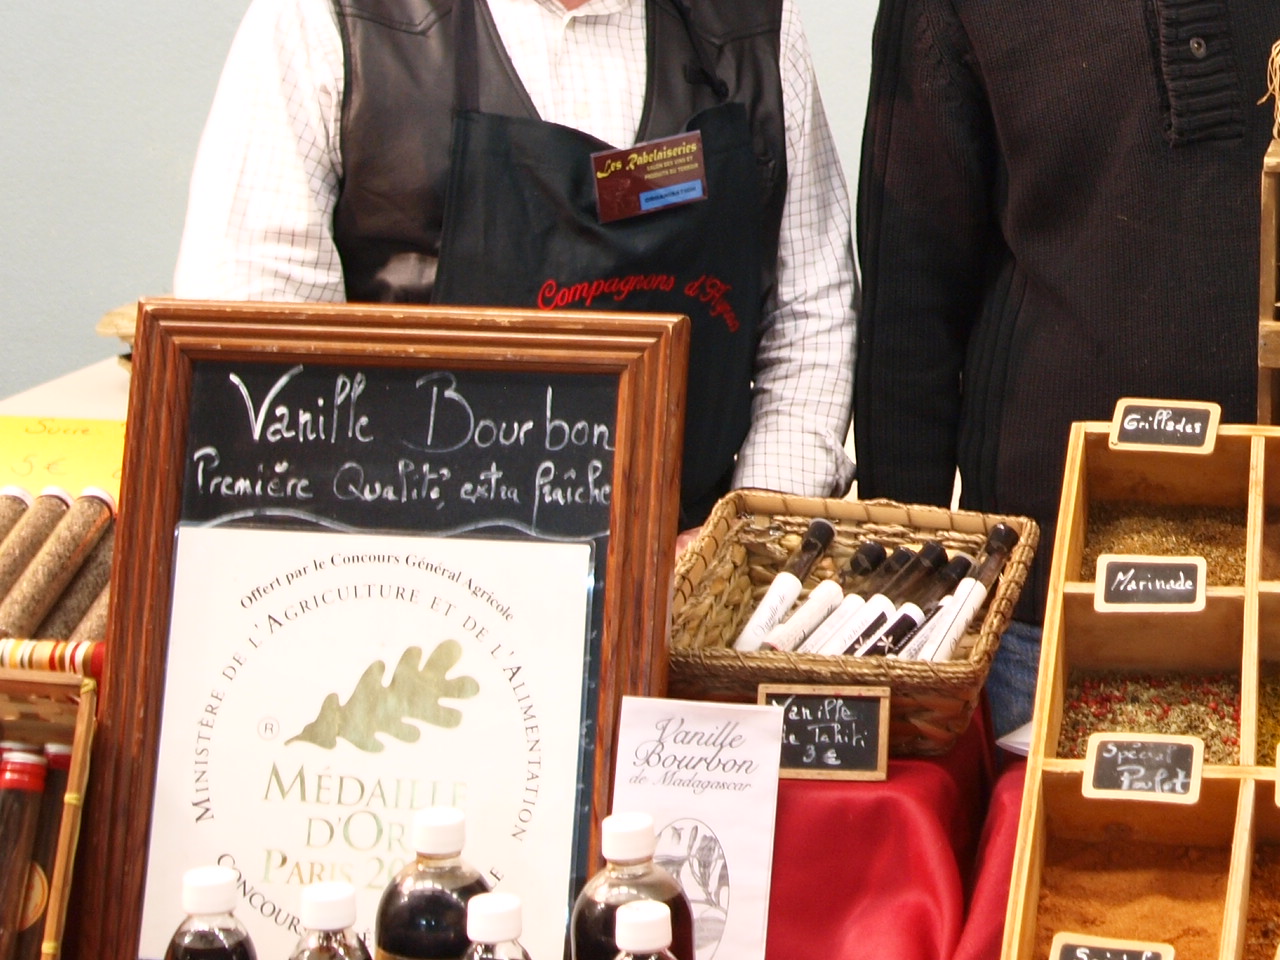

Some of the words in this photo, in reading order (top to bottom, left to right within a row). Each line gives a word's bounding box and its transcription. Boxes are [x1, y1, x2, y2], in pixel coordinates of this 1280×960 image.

[596, 160, 623, 178] Les
[626, 142, 698, 171] Rabelaiseries
[537, 274, 676, 311] Compagnons
[229, 364, 375, 444] Vanille
[401, 370, 616, 453] Bourbon
[1123, 409, 1203, 436] Grillades
[240, 577, 281, 610] Offert
[285, 565, 309, 586] par
[313, 559, 326, 571] le
[330, 552, 400, 567] Concours
[405, 553, 463, 583] Général
[464, 578, 515, 622] Agricole
[1111, 568, 1195, 592] Marinade
[191, 689, 226, 823] MINISTÈRE
[221, 652, 248, 681] DE
[430, 596, 456, 617] ET
[462, 616, 489, 642] DE
[655, 717, 746, 749] Vanille
[807, 721, 868, 748] Tahiti
[633, 741, 759, 775] Bourbon
[802, 744, 816, 763] 3
[628, 770, 648, 785] de
[652, 771, 752, 795] Madagascar
[1116, 765, 1191, 793] Poulet
[262, 848, 352, 886] PARIS
